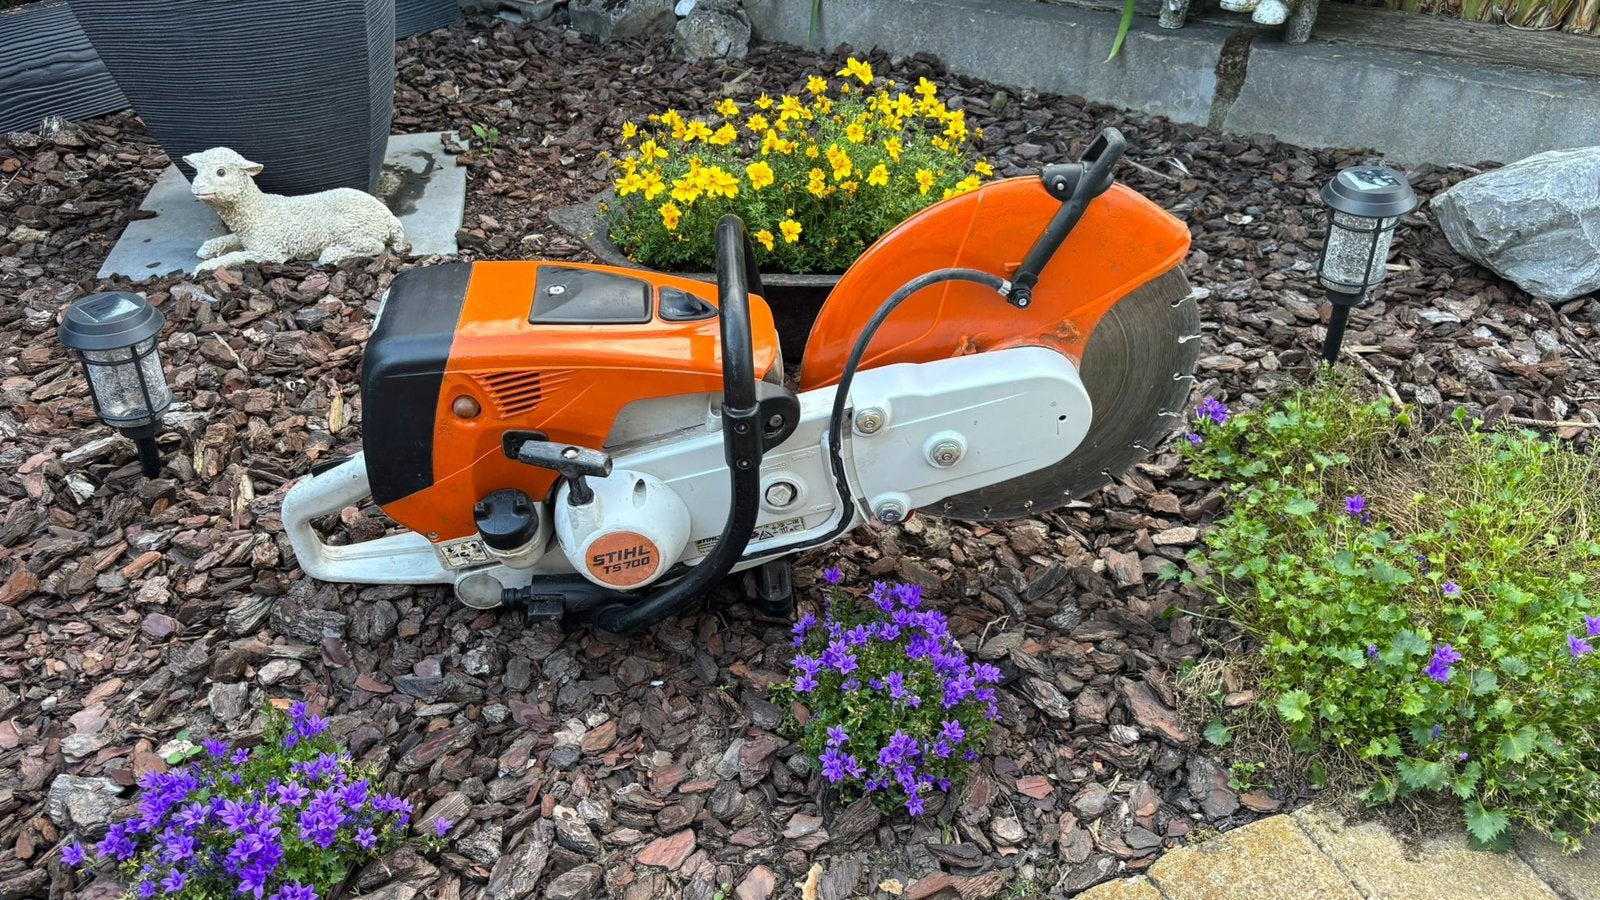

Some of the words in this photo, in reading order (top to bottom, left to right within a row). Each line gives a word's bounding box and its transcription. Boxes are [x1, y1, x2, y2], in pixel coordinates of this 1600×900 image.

[593, 545, 651, 567] STIHL
[603, 563, 622, 574] TS
[623, 556, 650, 569] 700
